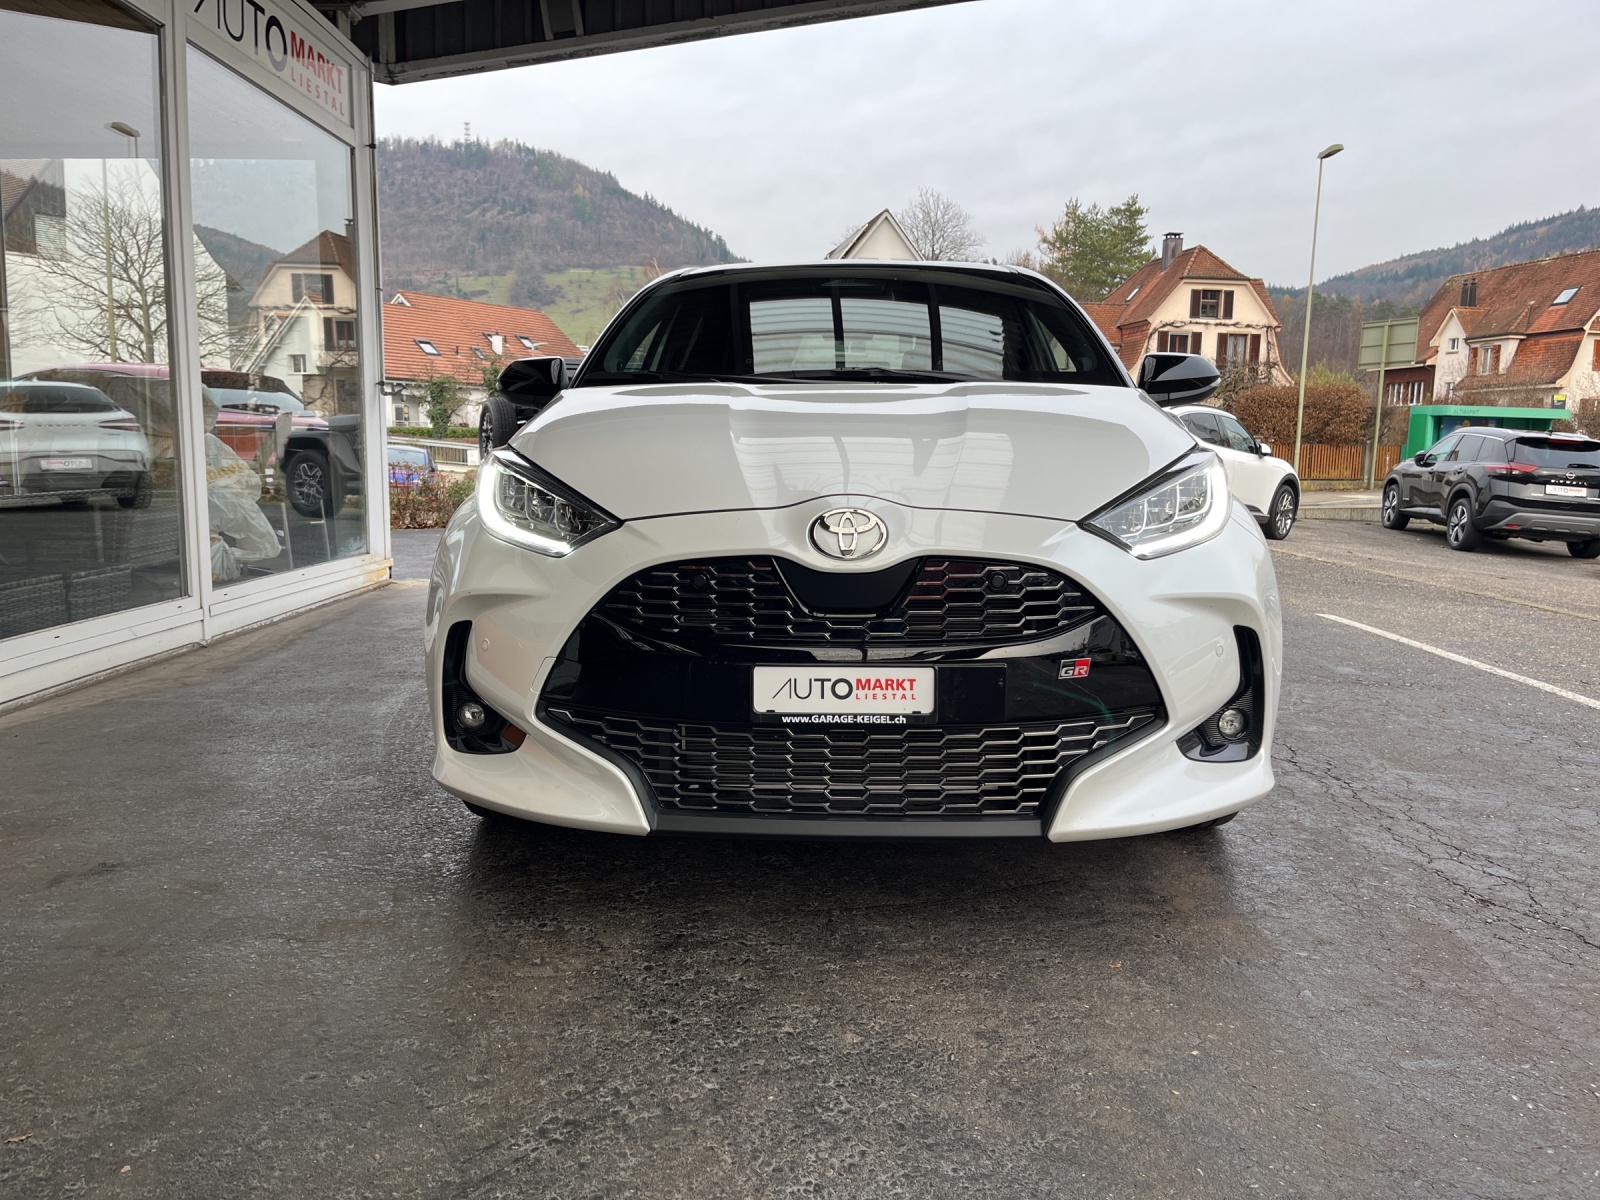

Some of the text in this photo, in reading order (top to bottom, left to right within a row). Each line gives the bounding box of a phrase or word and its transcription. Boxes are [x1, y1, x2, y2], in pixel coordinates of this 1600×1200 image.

[290, 30, 343, 94] MARKT
[290, 67, 345, 116] LIESTAL
[1061, 665, 1088, 677] GR
[772, 678, 917, 700] AUTO MARKT
[782, 714, 907, 724] www.GARAGE-KEIGEL.ch
